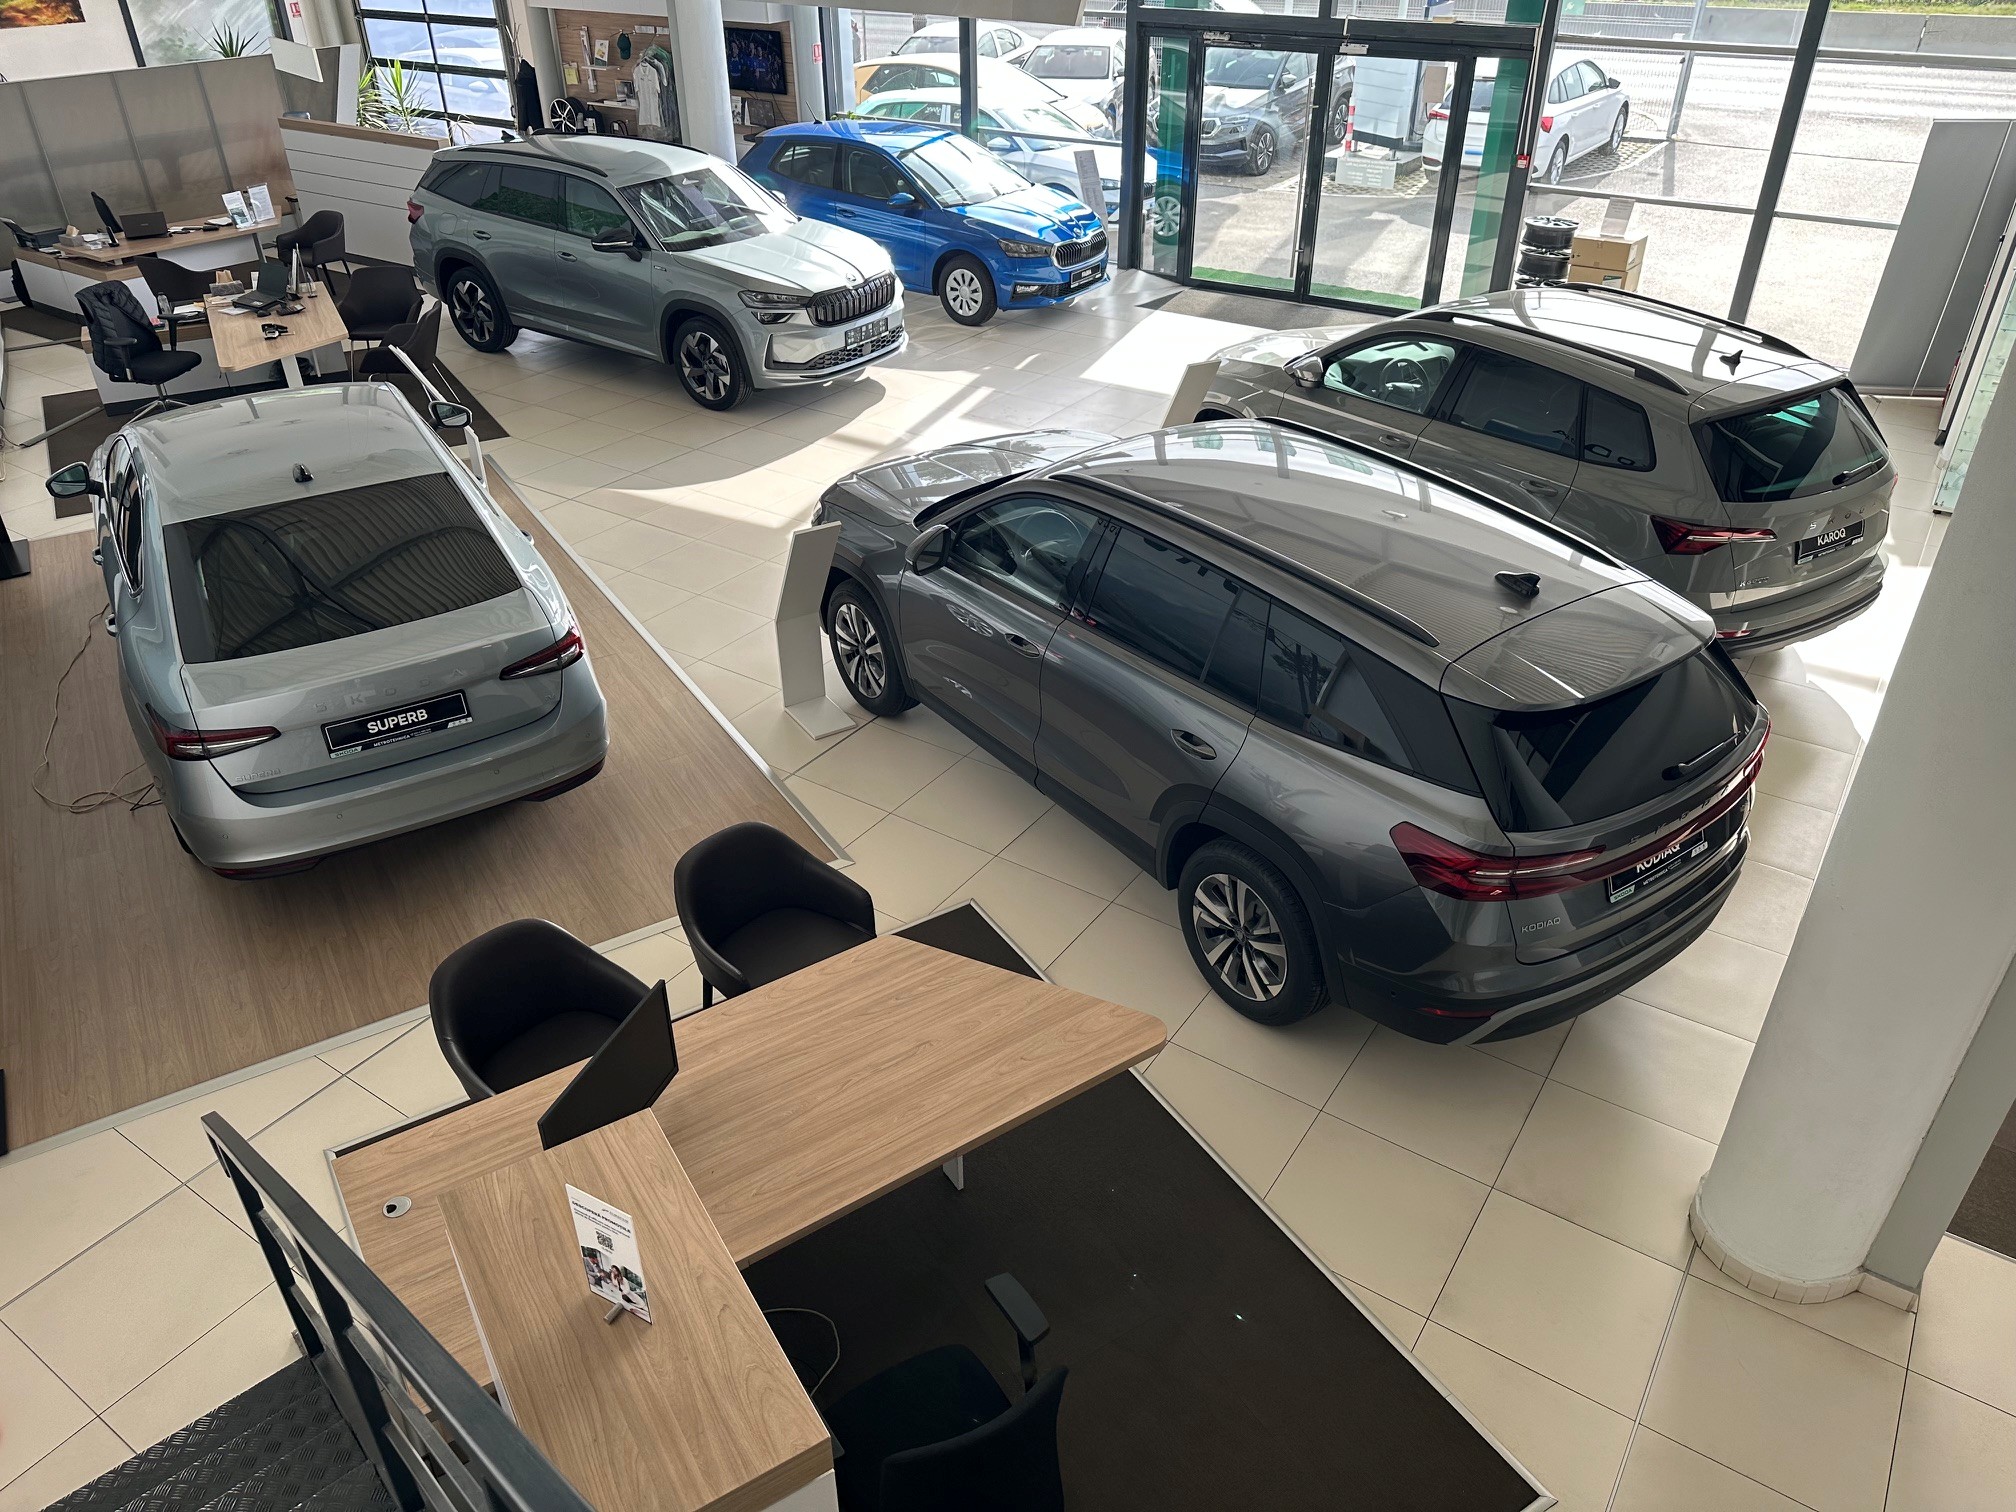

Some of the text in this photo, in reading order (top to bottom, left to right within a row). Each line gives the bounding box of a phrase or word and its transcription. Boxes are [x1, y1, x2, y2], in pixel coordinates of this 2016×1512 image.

[1817, 528, 1846, 547] KAROQ
[367, 709, 428, 734] SUPERB
[1636, 843, 1681, 873] KODIAQ
[1521, 916, 1561, 933] KODIAQ
